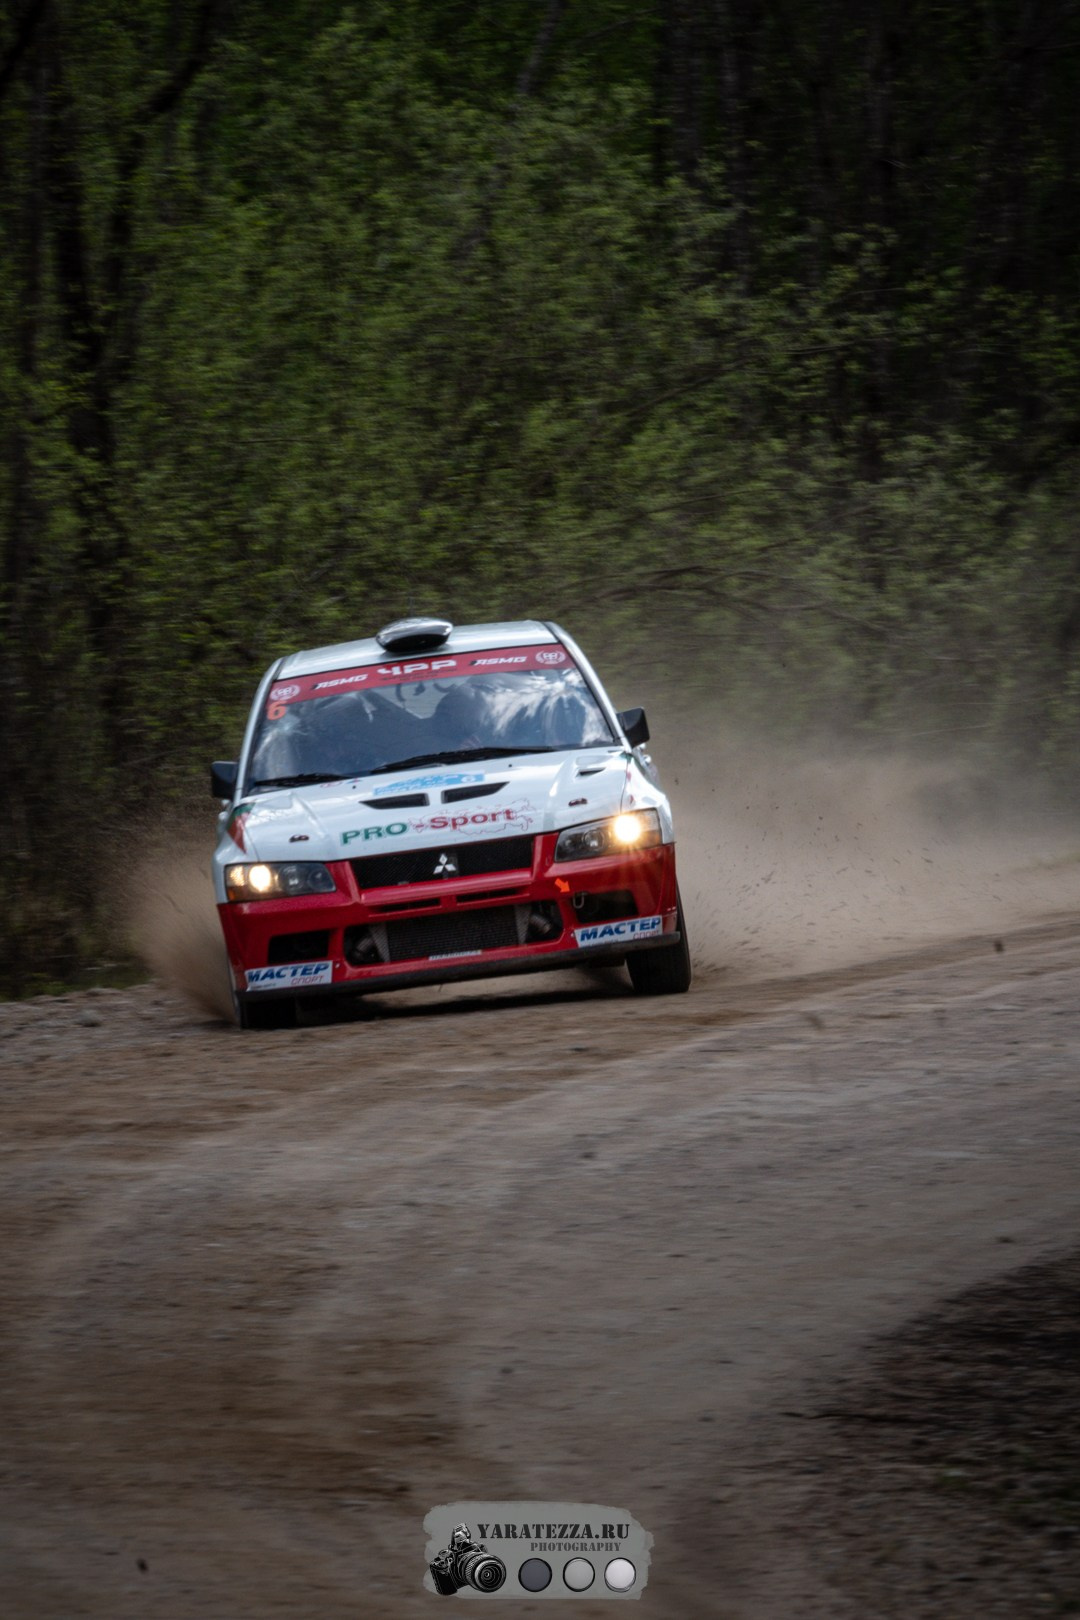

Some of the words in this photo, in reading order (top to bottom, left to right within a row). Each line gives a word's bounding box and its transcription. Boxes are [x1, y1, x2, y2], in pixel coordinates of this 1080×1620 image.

[267, 701, 287, 720] 6
[580, 917, 661, 942] МАСТЕР
[246, 962, 330, 984] МАСТЕР
